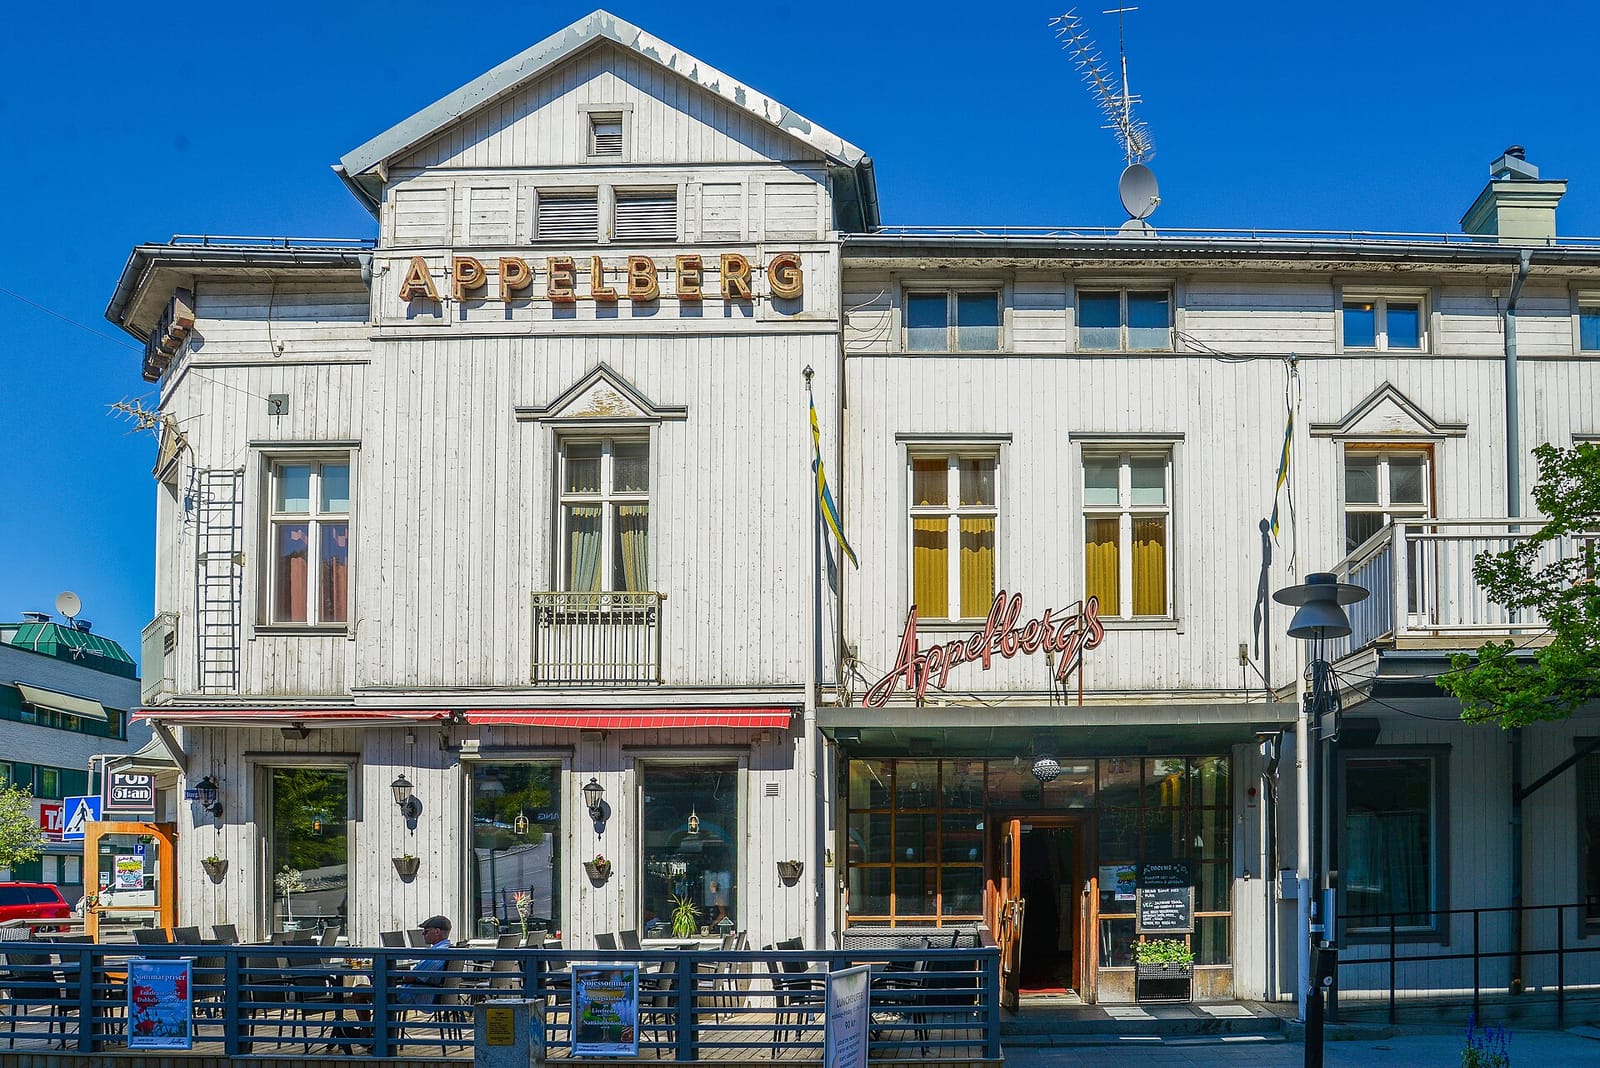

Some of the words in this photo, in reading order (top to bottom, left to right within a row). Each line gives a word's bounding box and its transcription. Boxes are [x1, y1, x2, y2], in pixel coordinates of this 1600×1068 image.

[398, 252, 803, 303] APPELBERG
[862, 589, 1104, 708] Appelbergs
[137, 845, 144, 853] P
